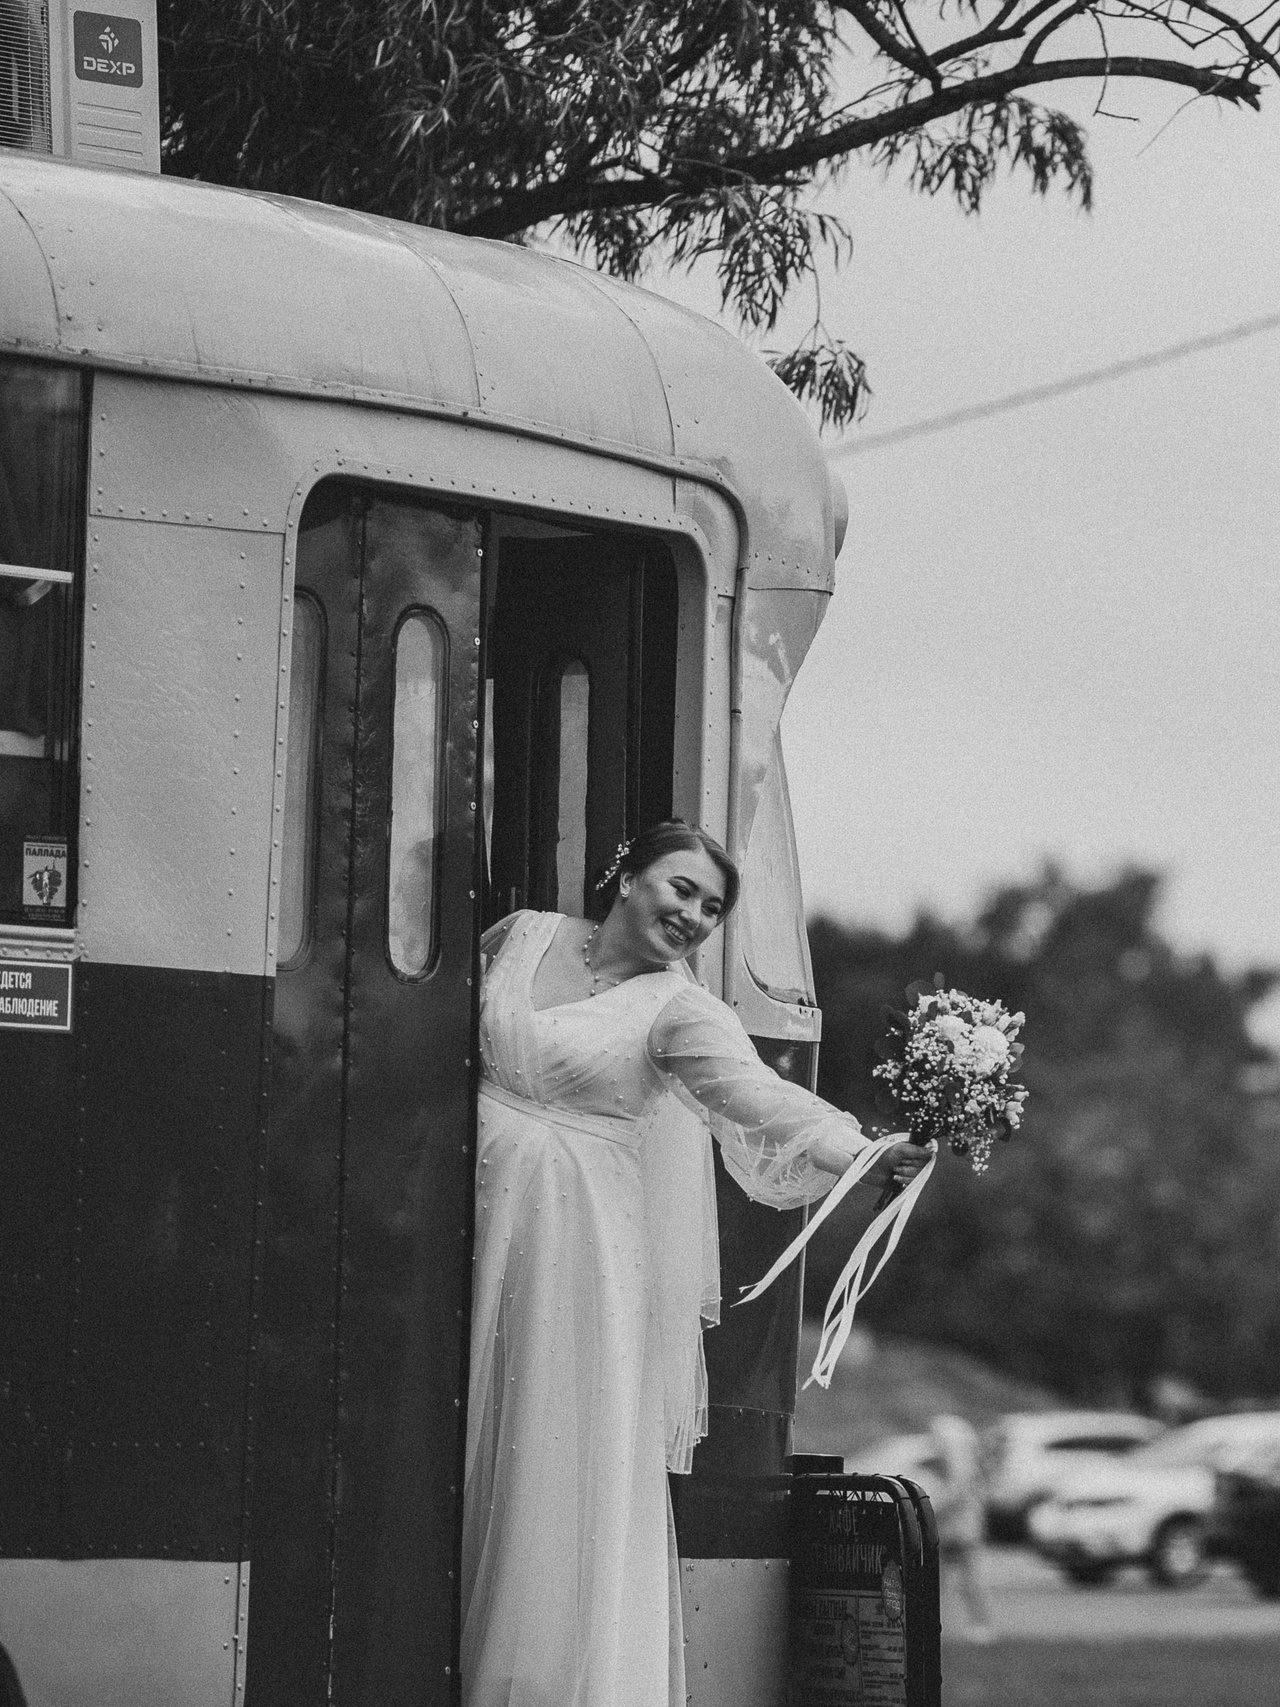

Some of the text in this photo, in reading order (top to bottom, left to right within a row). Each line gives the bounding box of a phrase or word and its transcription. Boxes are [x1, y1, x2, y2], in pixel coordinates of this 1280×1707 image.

[83, 56, 136, 76] DEXP
[25, 848, 66, 859] ПАЛЛАДА
[0, 971, 32, 990] ДЕТСЯ
[0, 997, 59, 1017] АБЛЮДЕНИЕ
